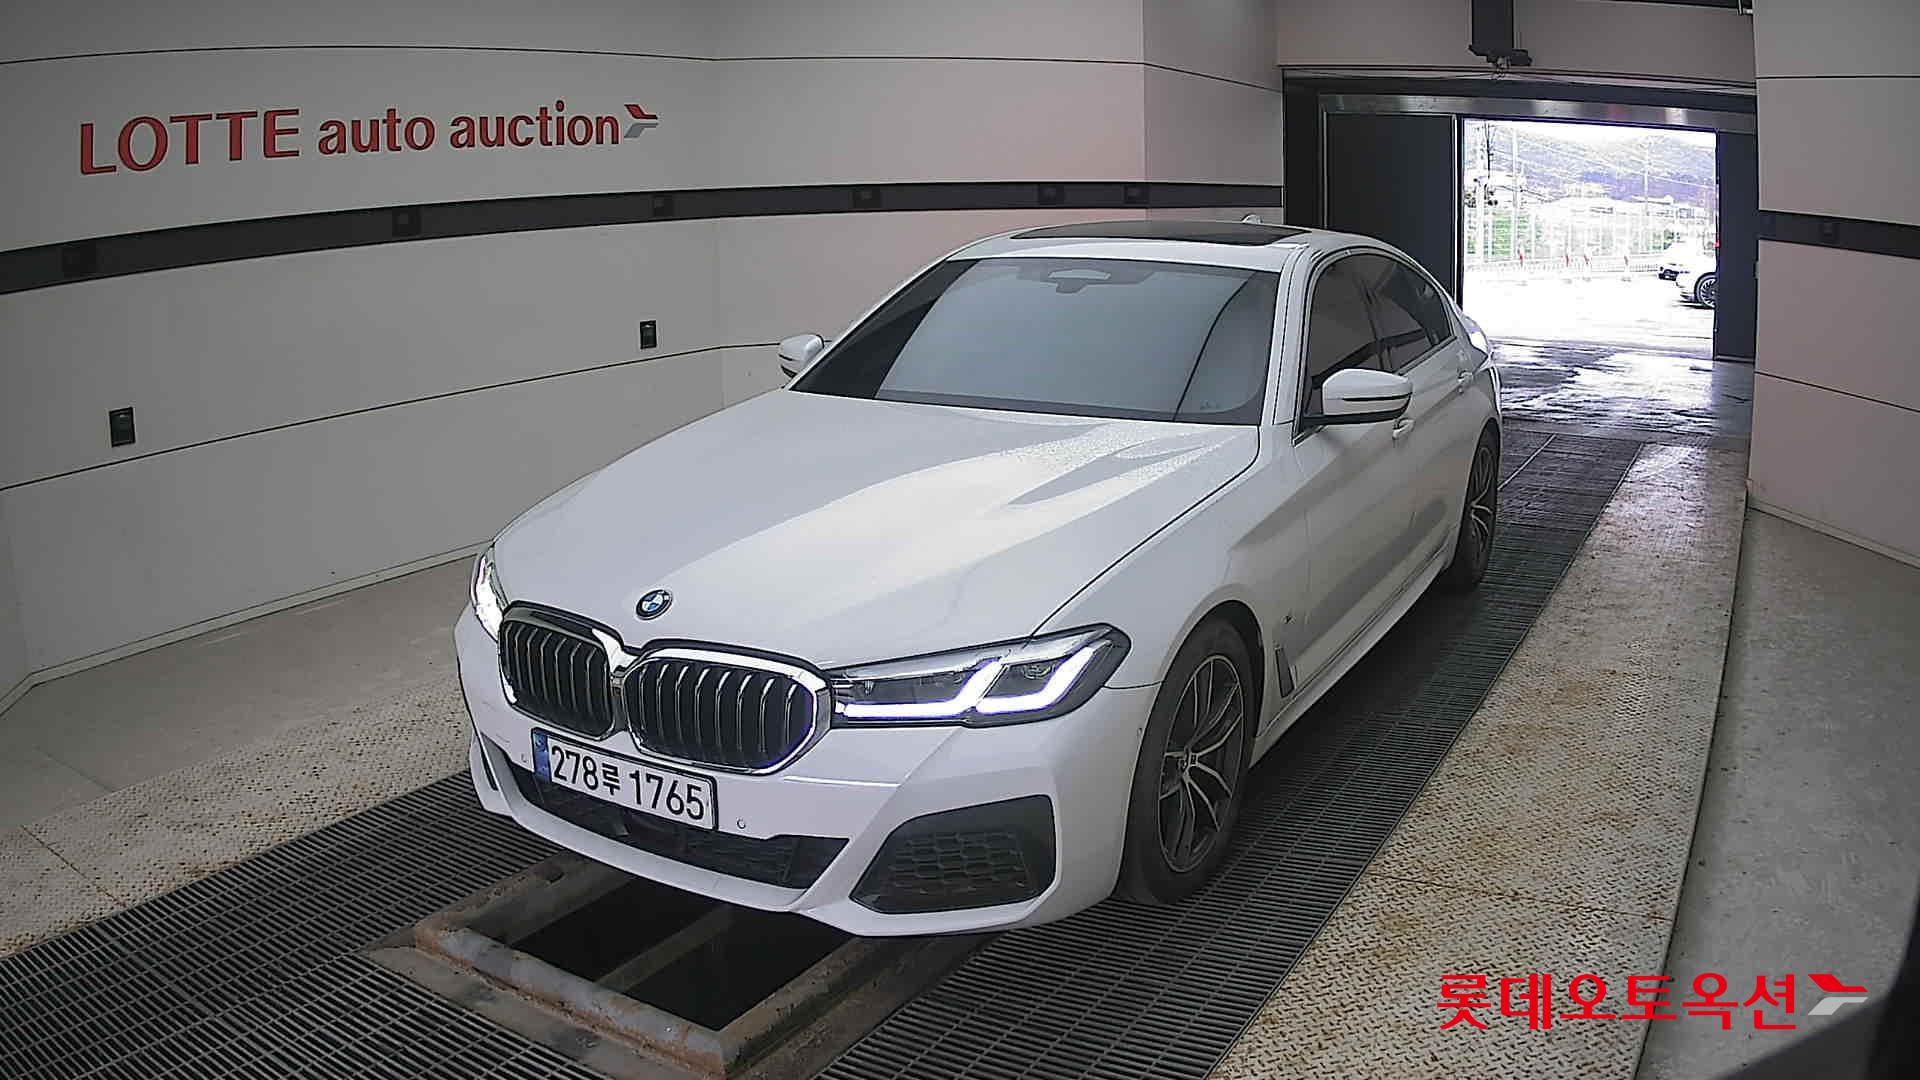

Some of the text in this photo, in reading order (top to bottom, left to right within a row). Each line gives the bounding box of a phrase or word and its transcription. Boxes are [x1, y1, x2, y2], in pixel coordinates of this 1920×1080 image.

[80, 100, 620, 175] LOTTE auto auction
[551, 746, 704, 821] 278루 1765
